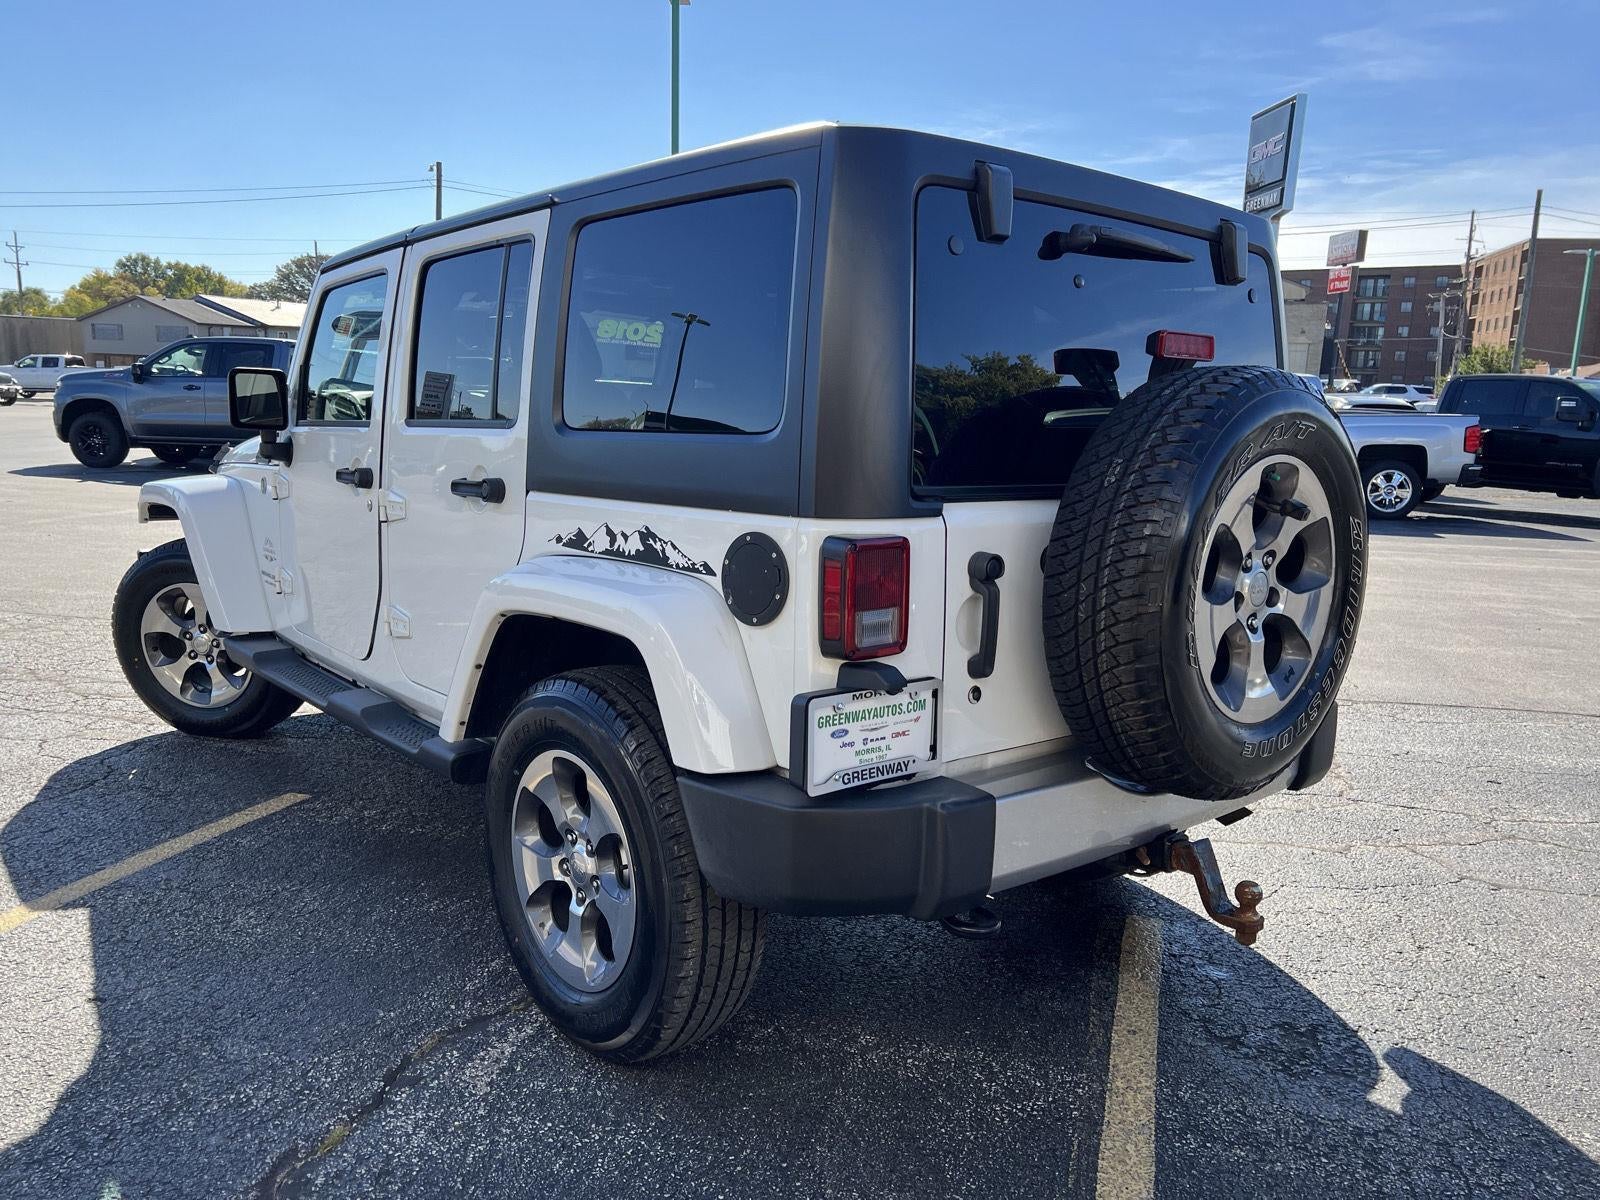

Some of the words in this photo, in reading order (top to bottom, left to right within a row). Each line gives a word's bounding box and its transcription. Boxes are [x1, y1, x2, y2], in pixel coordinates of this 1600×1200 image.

[1249, 132, 1285, 164] GMC
[1245, 192, 1278, 213] GREENWAY
[1260, 420, 1317, 449] A/T
[1241, 515, 1364, 758] BRIDGESTONE
[817, 698, 927, 729] GREENWAYAUTOS.COM
[840, 741, 856, 749] Jeep
[891, 729, 910, 739] GMC
[855, 746, 885, 757] MORRIS,
[885, 744, 892, 752] IL
[858, 756, 874, 765] Since
[841, 760, 911, 785] GREENWAY
